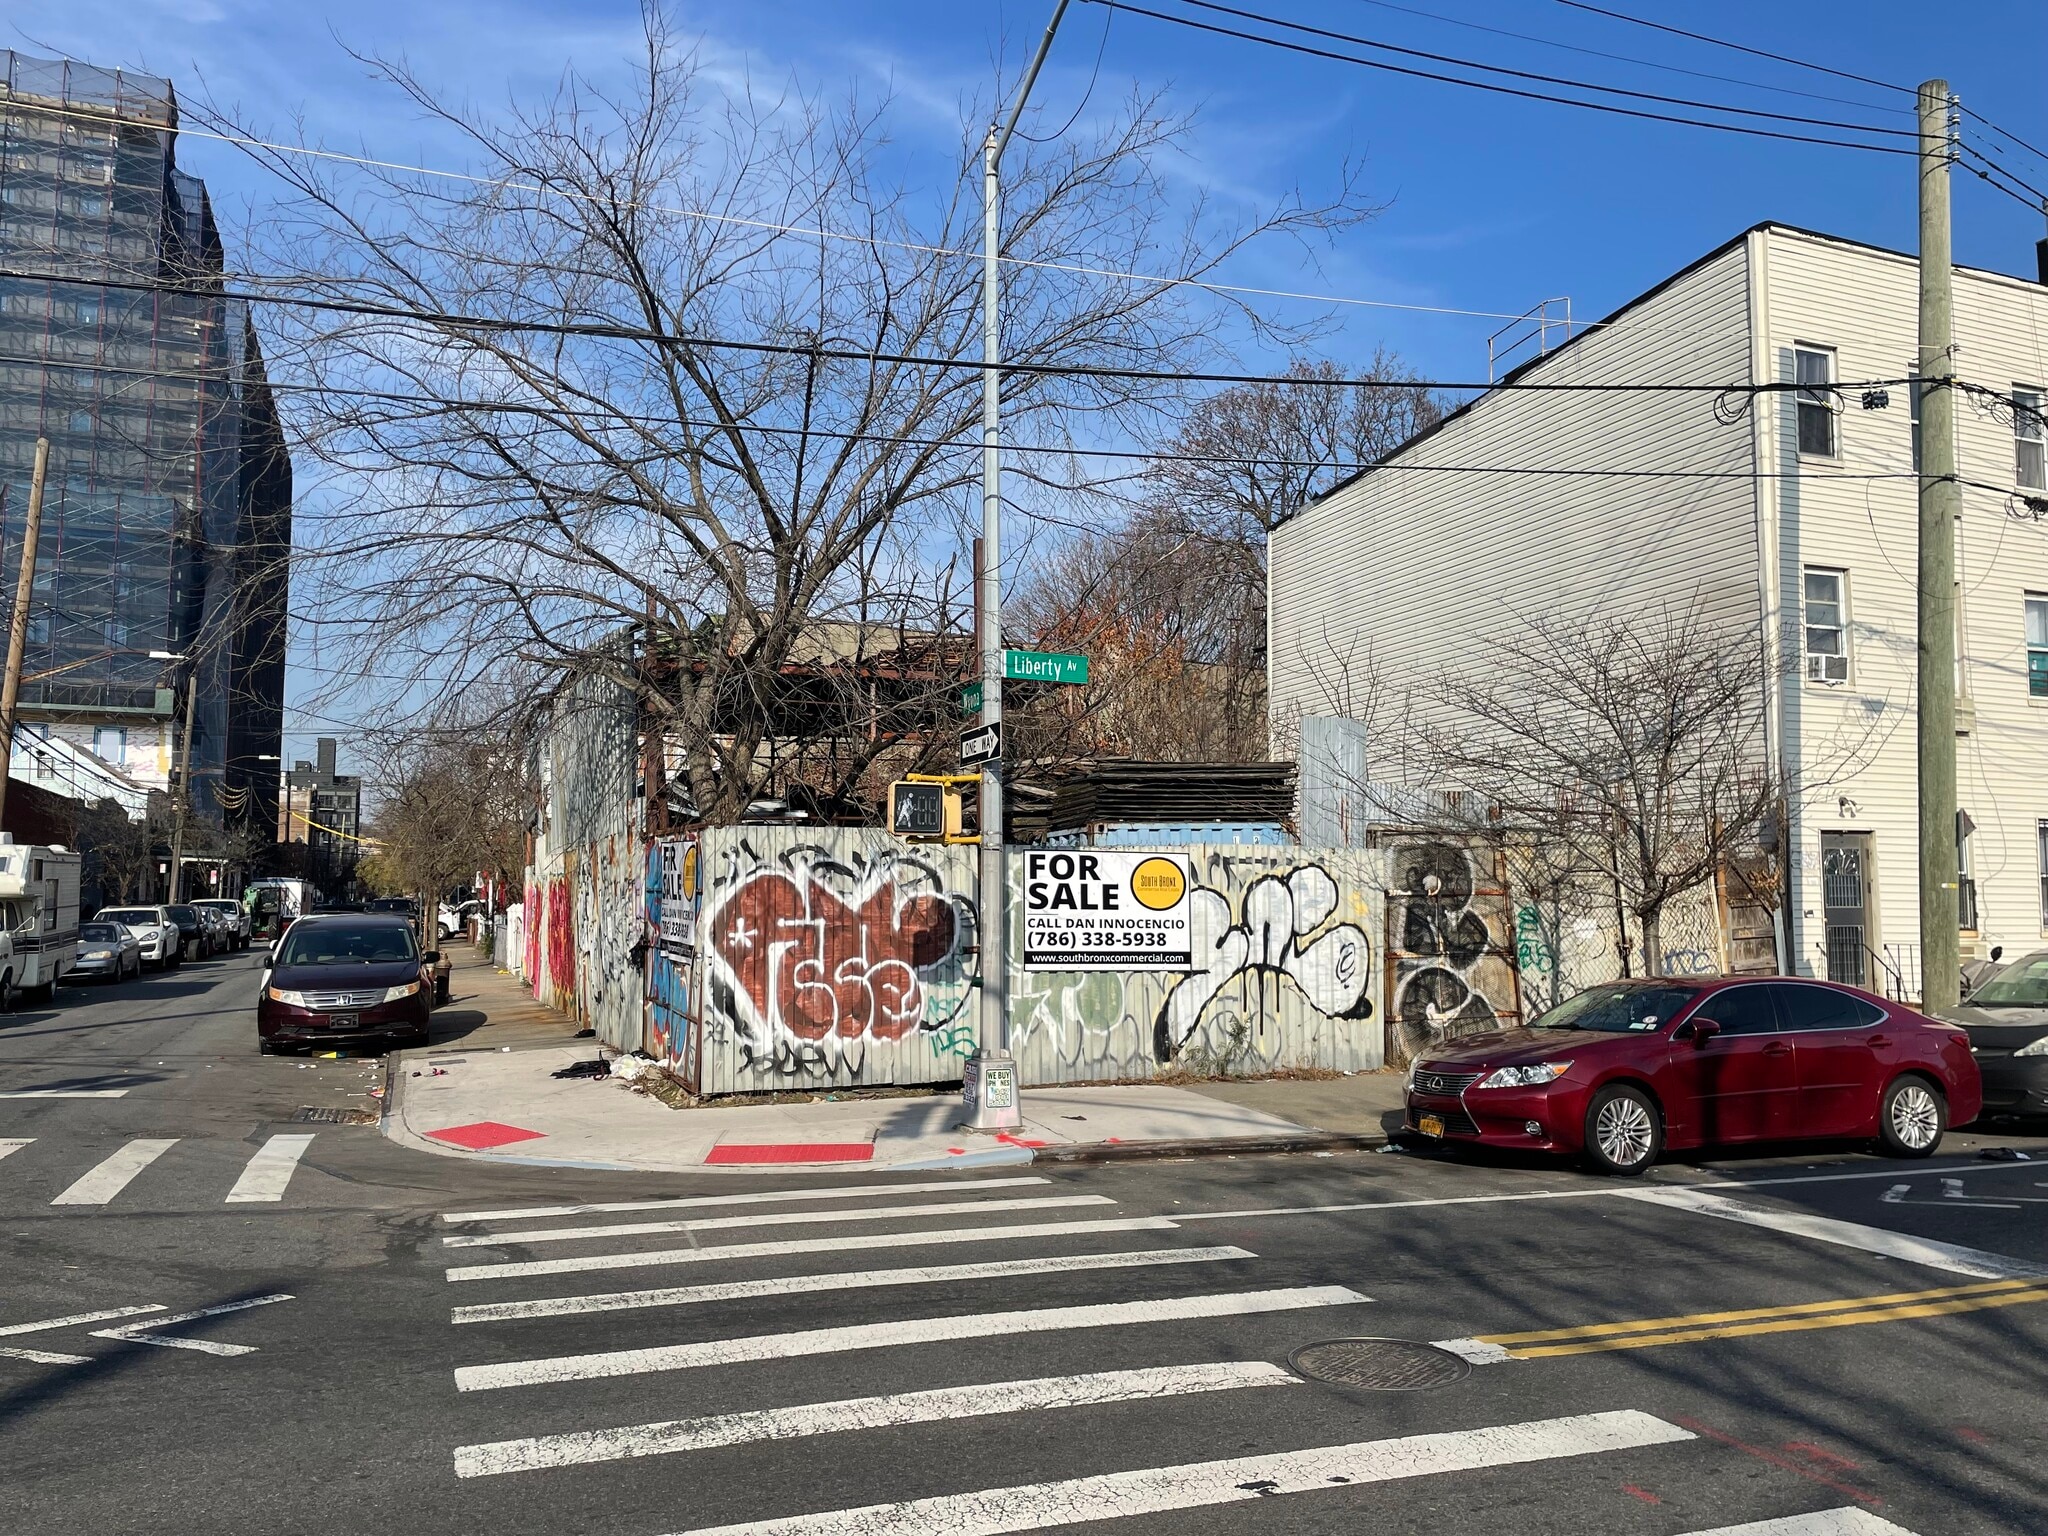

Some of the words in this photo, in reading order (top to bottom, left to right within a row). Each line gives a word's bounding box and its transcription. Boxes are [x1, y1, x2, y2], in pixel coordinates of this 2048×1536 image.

[1014, 655, 1062, 681] Liberty
[1067, 660, 1077, 671] Av
[965, 740, 977, 756] ONE
[981, 734, 995, 751] WAY
[1029, 854, 1101, 881] FOR
[1028, 882, 1119, 911] SALE
[1027, 918, 1062, 929] CALL
[1066, 919, 1095, 929] DAN
[1099, 919, 1185, 930] INNOCENCIO
[1027, 931, 1077, 949] (786)
[1082, 932, 1167, 947] 338-5938
[1032, 952, 1184, 964] www.southbronxcommercial.com
[987, 1071, 997, 1080] WE
[998, 1071, 1010, 1079] BUY
